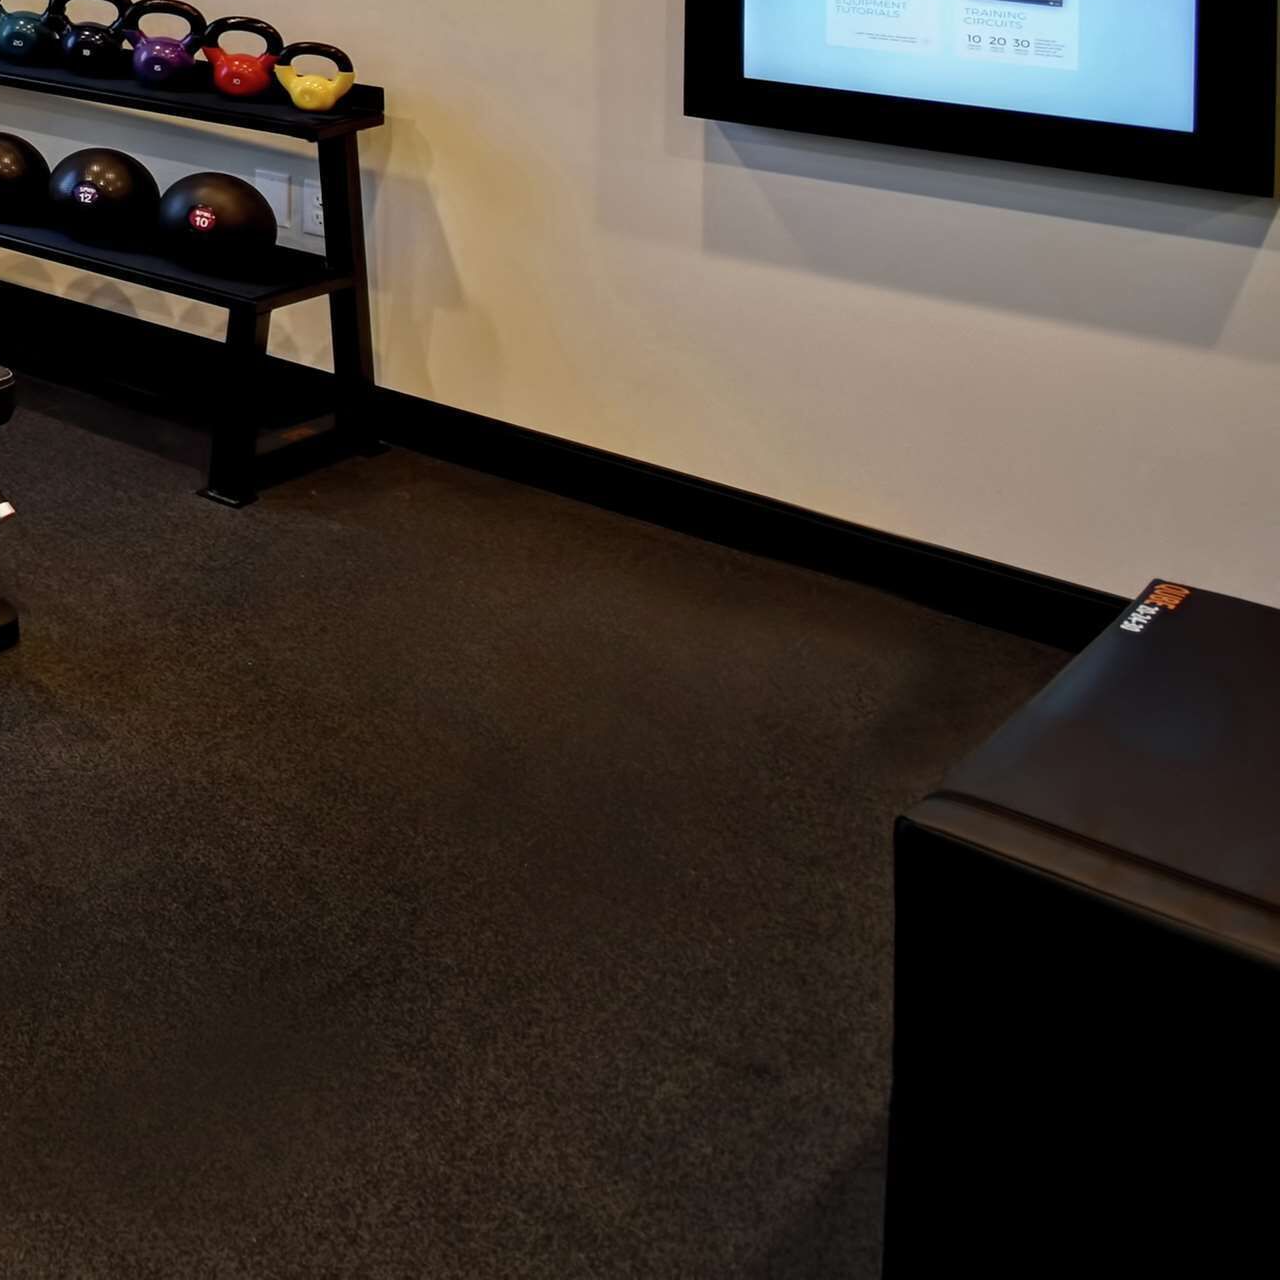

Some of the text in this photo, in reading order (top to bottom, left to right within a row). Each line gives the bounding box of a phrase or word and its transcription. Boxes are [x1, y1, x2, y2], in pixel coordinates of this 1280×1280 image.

[836, 5, 901, 18] TUTORIALS
[964, 7, 1027, 21] TRAINING
[964, 17, 1023, 30] CIRCUITS
[968, 34, 981, 44] 10
[989, 36, 1007, 46] 20
[1013, 38, 1030, 49] 30
[80, 193, 92, 203] 12
[195, 216, 208, 227] 10
